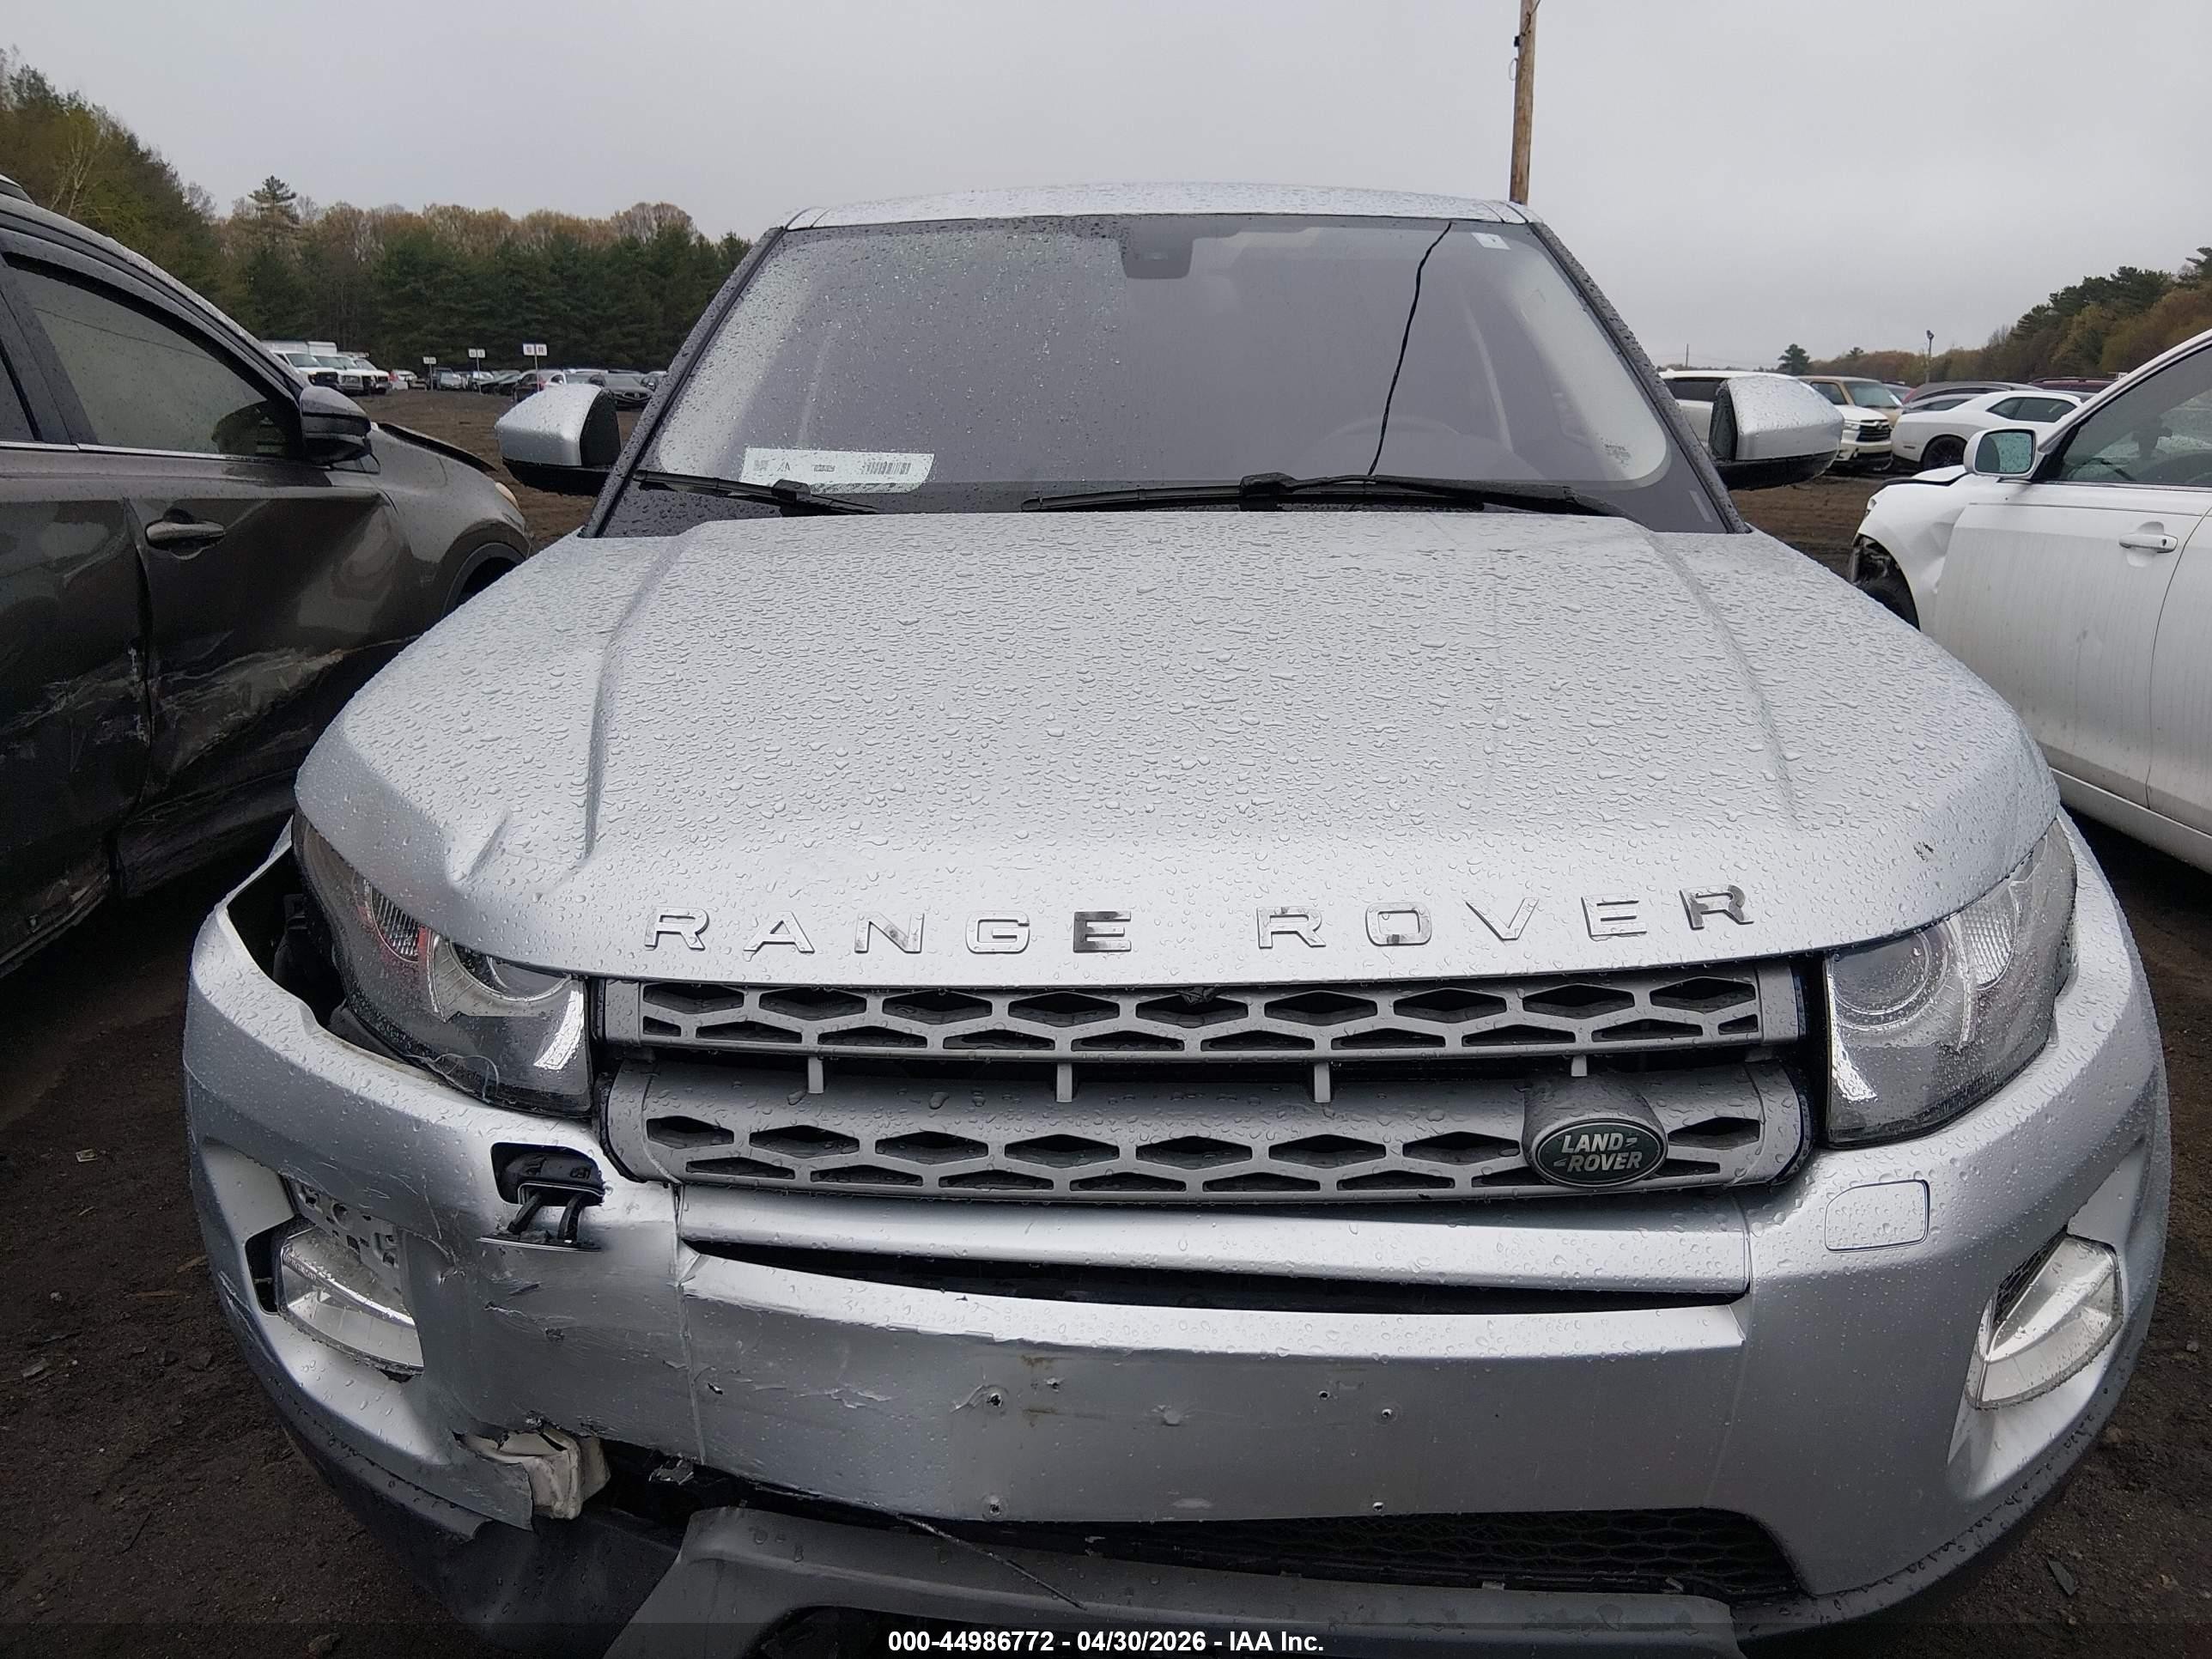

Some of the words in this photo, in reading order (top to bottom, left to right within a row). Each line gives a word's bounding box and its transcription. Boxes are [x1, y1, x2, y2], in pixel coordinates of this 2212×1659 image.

[644, 907, 1132, 954] RANGE
[1257, 884, 1753, 948] ROVER
[1561, 1133, 1624, 1153] LAND
[1567, 1152, 1643, 1173] ROVER
